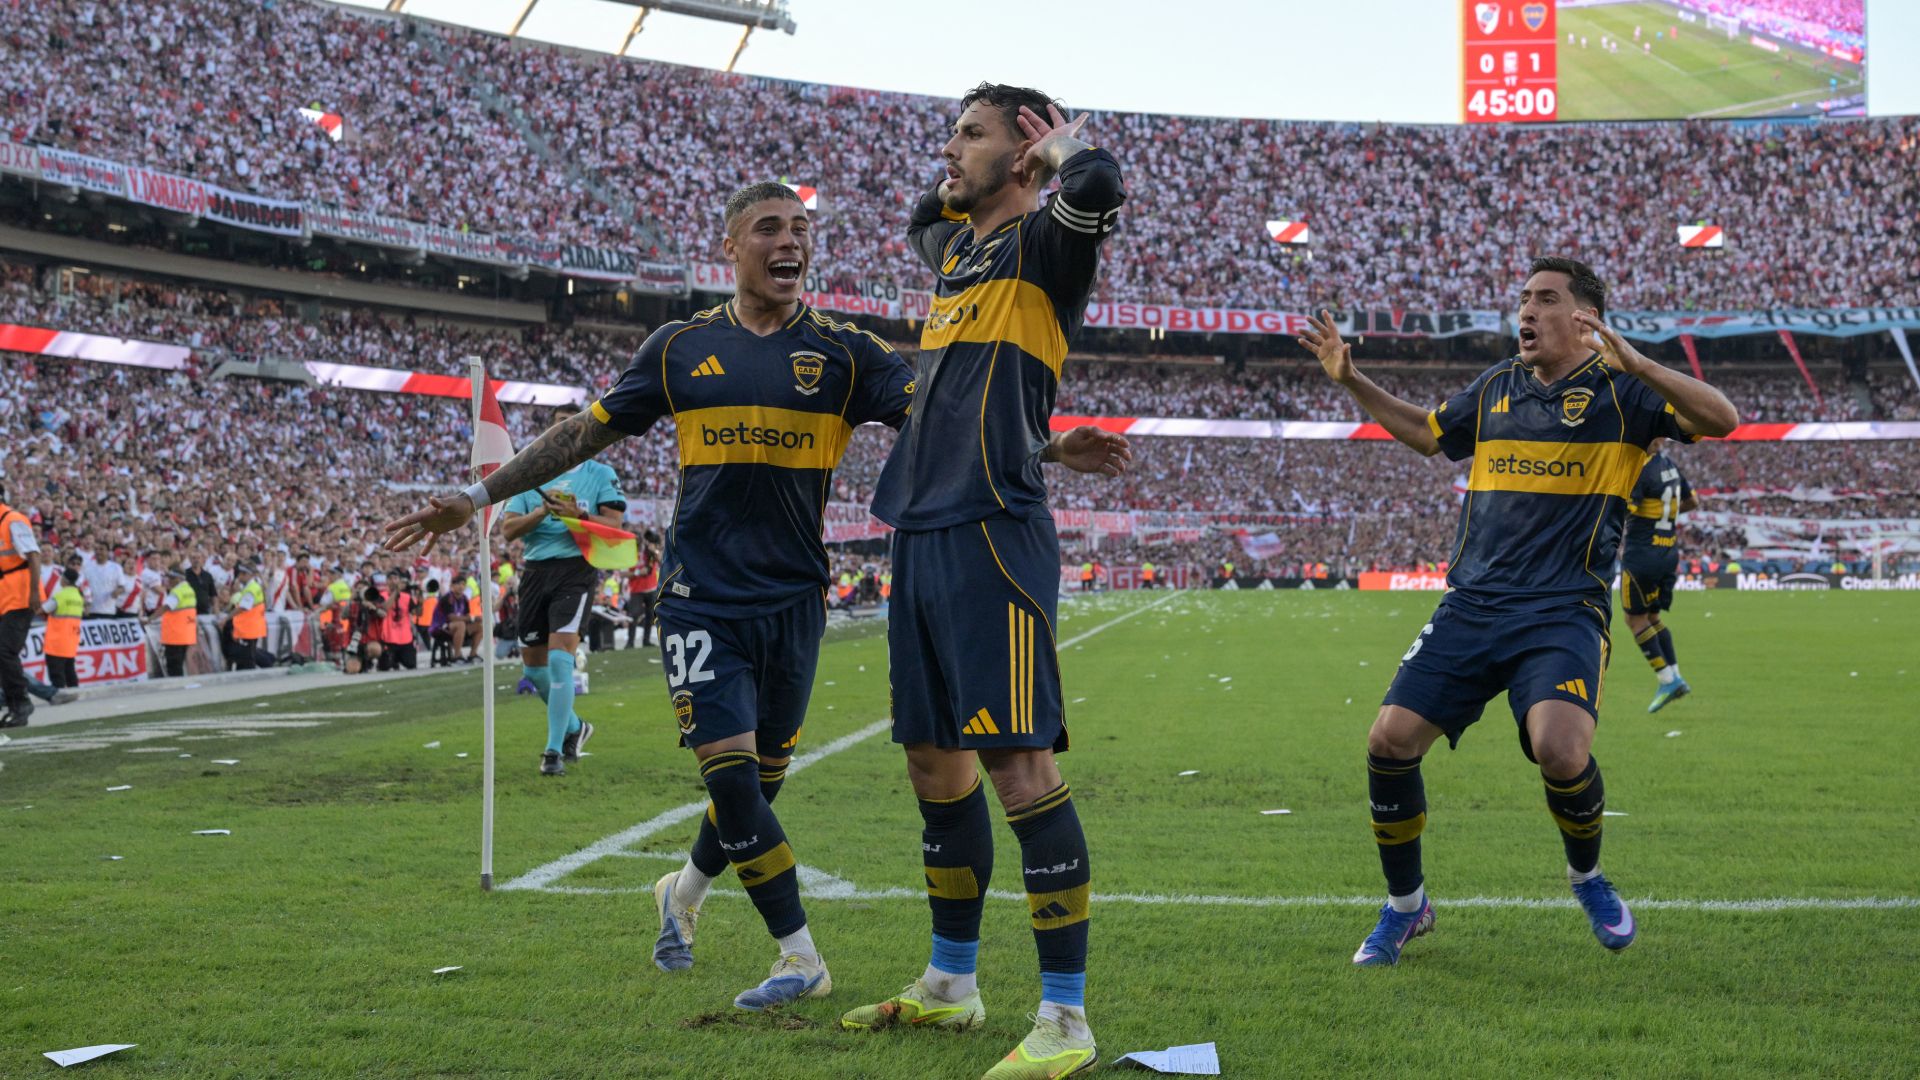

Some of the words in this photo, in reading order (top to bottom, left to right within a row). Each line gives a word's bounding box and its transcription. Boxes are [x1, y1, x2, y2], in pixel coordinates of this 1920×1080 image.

[1479, 53, 1495, 73] 0
[1529, 52, 1540, 73] 1
[1467, 88, 1556, 116] 45:00
[210, 191, 300, 230] JAUREGUI
[560, 244, 637, 272] CARDALES
[798, 366, 818, 374] CABJ
[701, 421, 815, 449] betsson
[1488, 454, 1585, 477] betsson
[665, 629, 715, 687] 32
